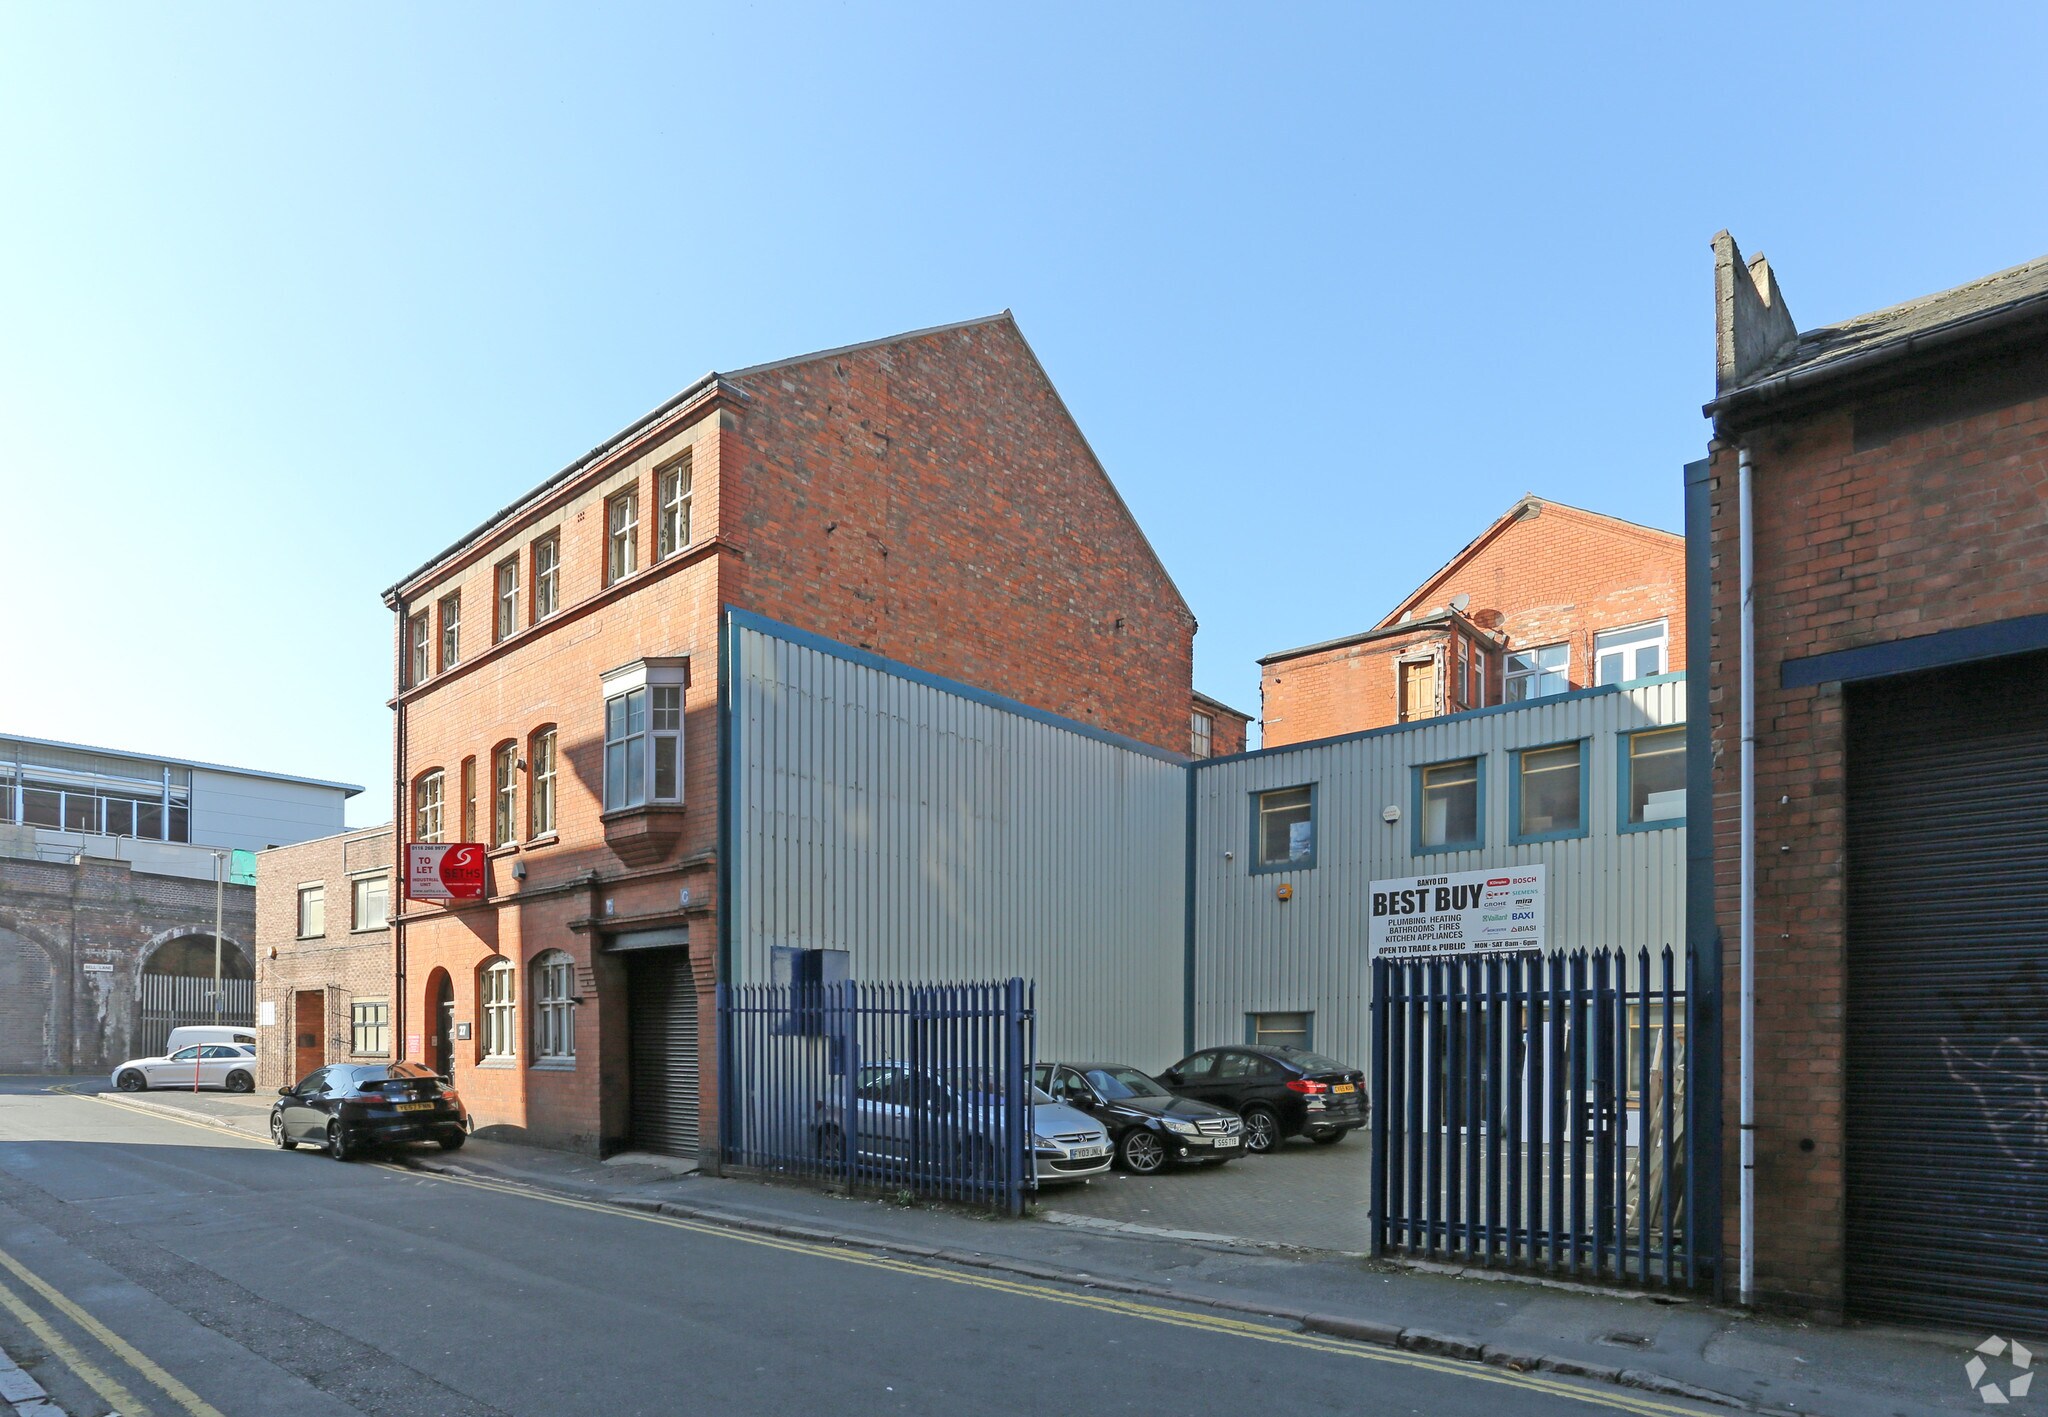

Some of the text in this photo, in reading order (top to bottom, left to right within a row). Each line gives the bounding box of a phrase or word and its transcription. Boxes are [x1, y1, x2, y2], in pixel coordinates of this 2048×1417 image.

[444, 868, 480, 878] SETHS
[1417, 878, 1436, 886] BANYO
[1373, 884, 1483, 916] BEST BUY
[1388, 914, 1462, 926] PLUMBING HEATING
[1512, 912, 1534, 920] BAXI
[1390, 924, 1434, 934] BATHROOMS
[1386, 931, 1463, 942] KITCHEN APPLIANCES
[1439, 942, 1466, 951] PUBLIC
[459, 1025, 466, 1036] 27
